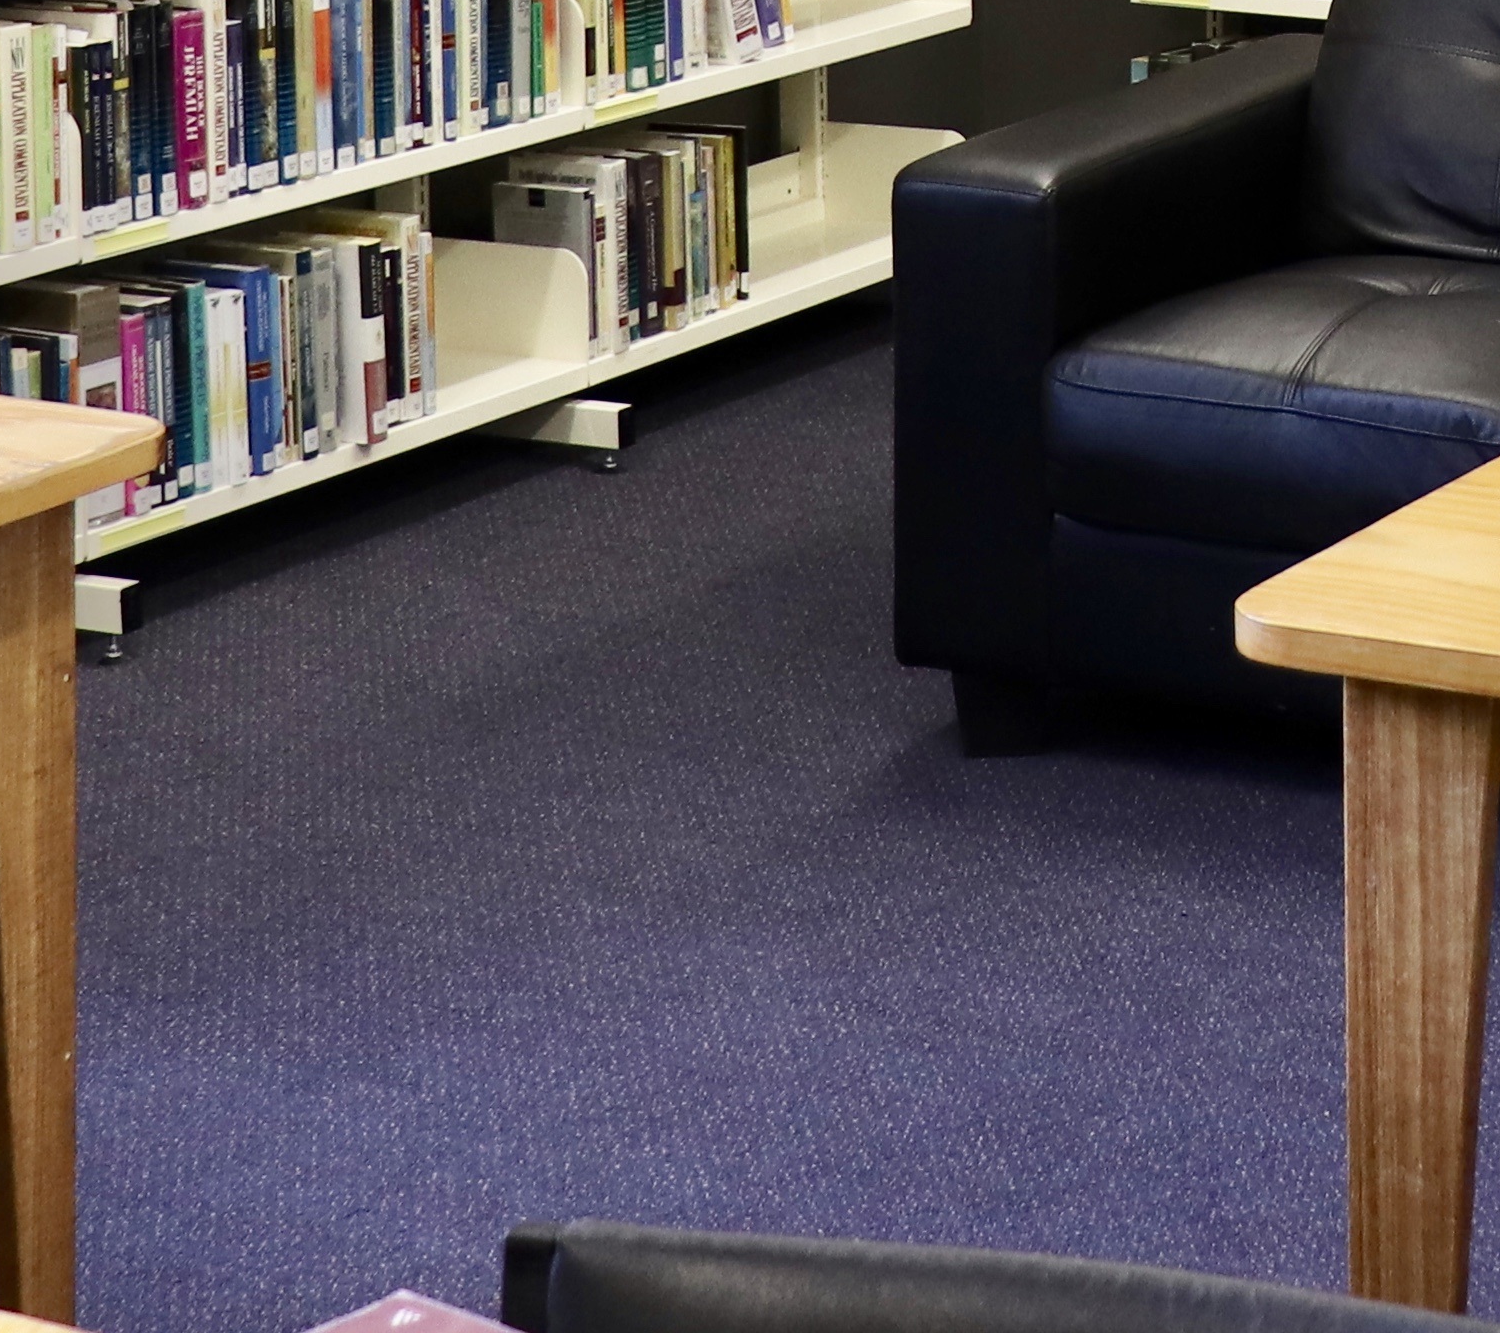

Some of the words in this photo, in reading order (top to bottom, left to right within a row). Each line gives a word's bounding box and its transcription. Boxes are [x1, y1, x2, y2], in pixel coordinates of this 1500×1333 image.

[183, 45, 199, 141] JEREMIAH
[193, 295, 205, 342] MINOR
[195, 344, 207, 406] PROPHETS
